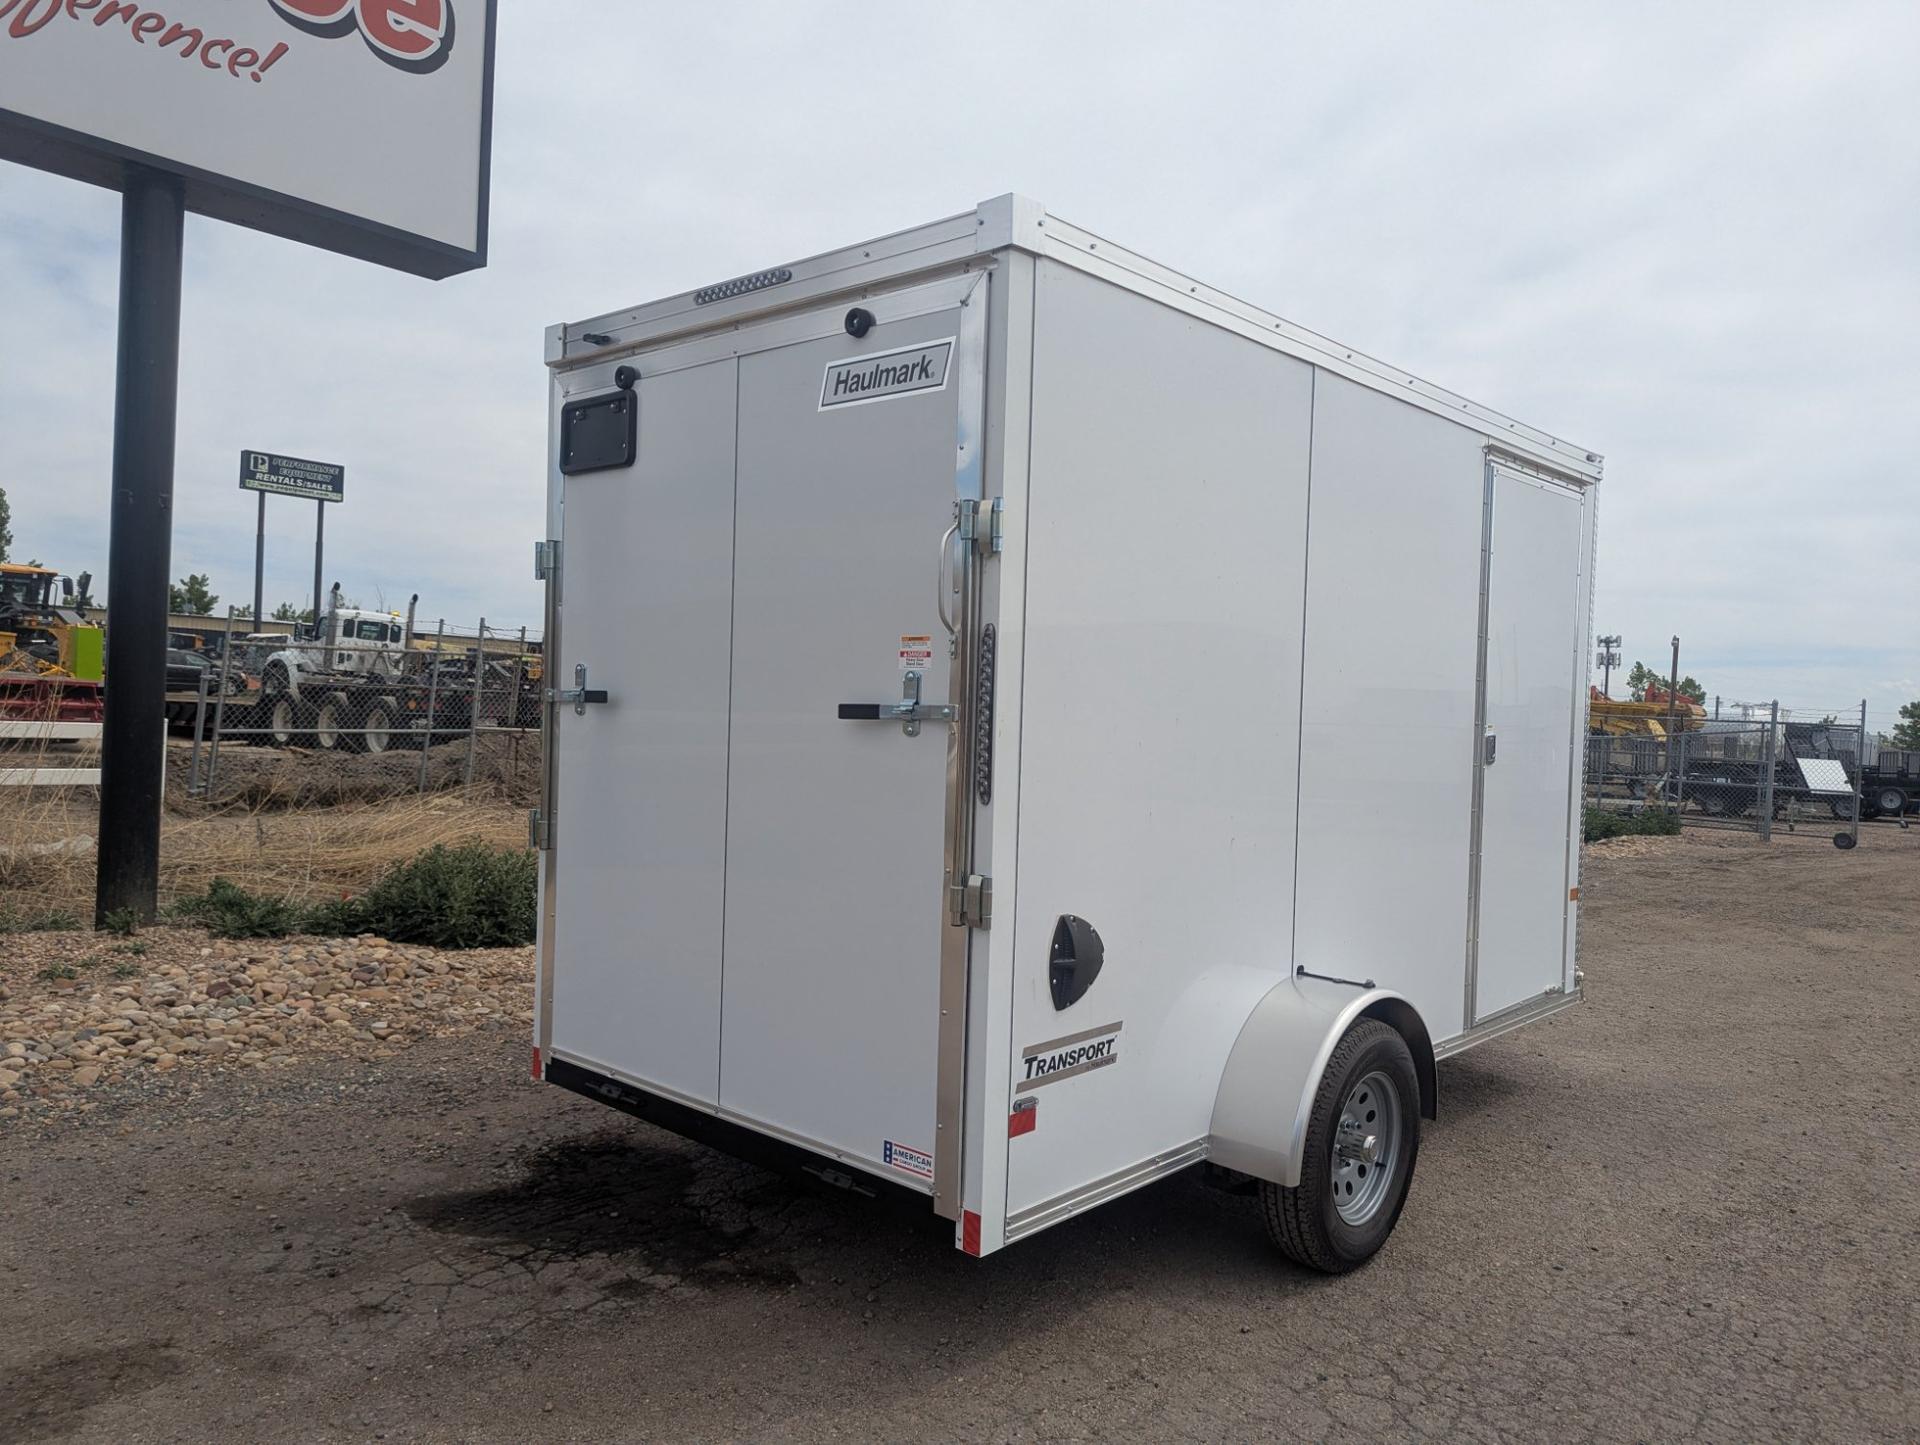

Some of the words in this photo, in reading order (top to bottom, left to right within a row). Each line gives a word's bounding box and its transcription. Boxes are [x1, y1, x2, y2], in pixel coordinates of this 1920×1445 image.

[833, 354, 933, 396] Haulmark
[1023, 1038, 1116, 1080] TRANSPORT
[893, 1149, 932, 1168] AMERICAN
